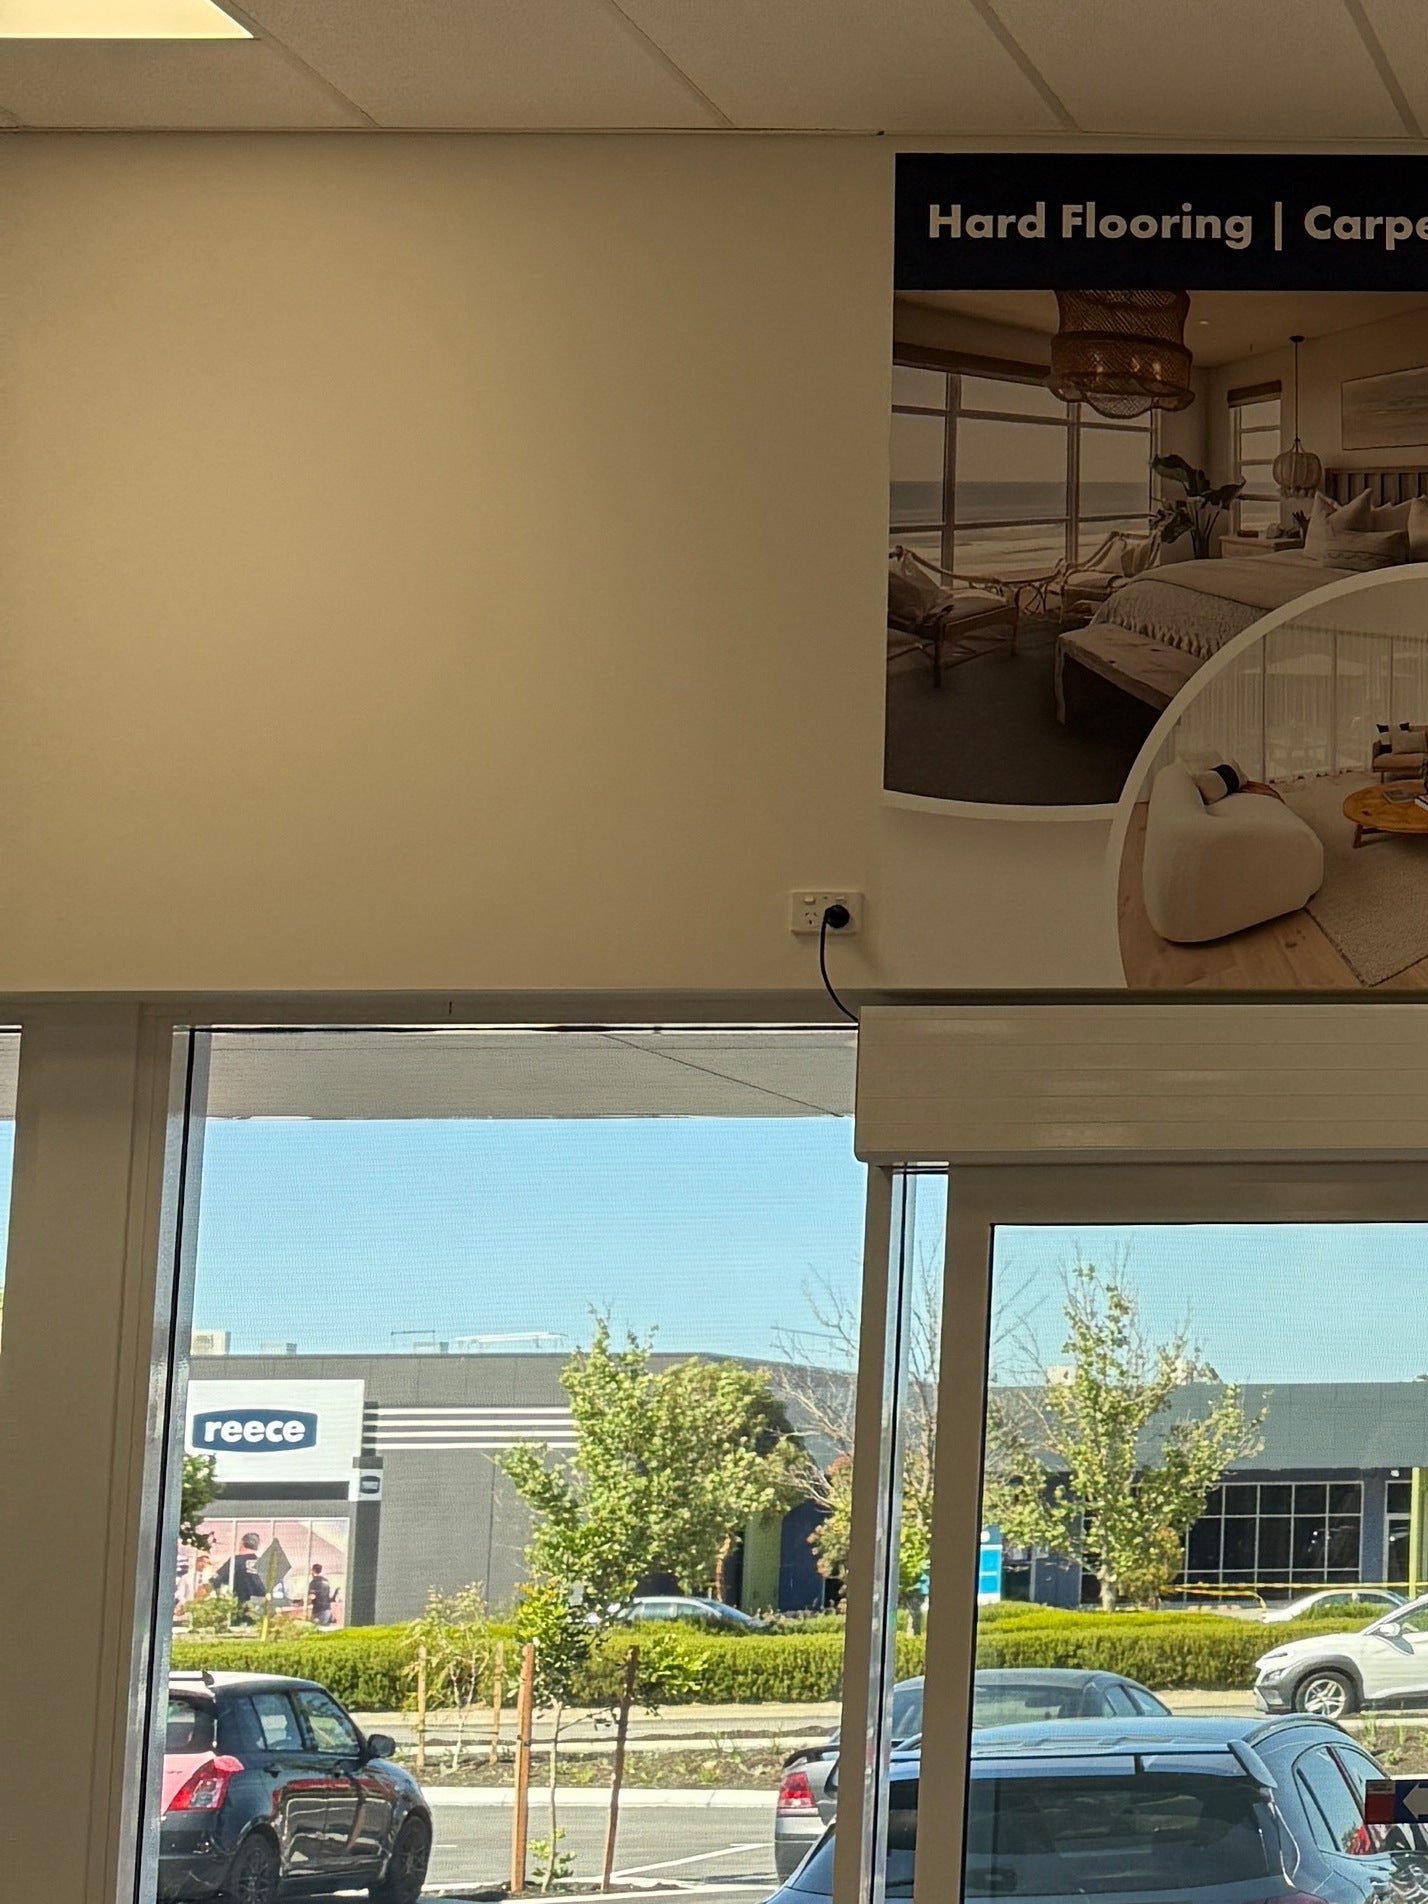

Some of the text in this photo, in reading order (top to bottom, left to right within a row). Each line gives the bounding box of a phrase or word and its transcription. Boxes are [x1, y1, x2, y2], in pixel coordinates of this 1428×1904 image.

[929, 201, 1253, 250] Hard Flooring
[203, 1419, 306, 1443] reece
